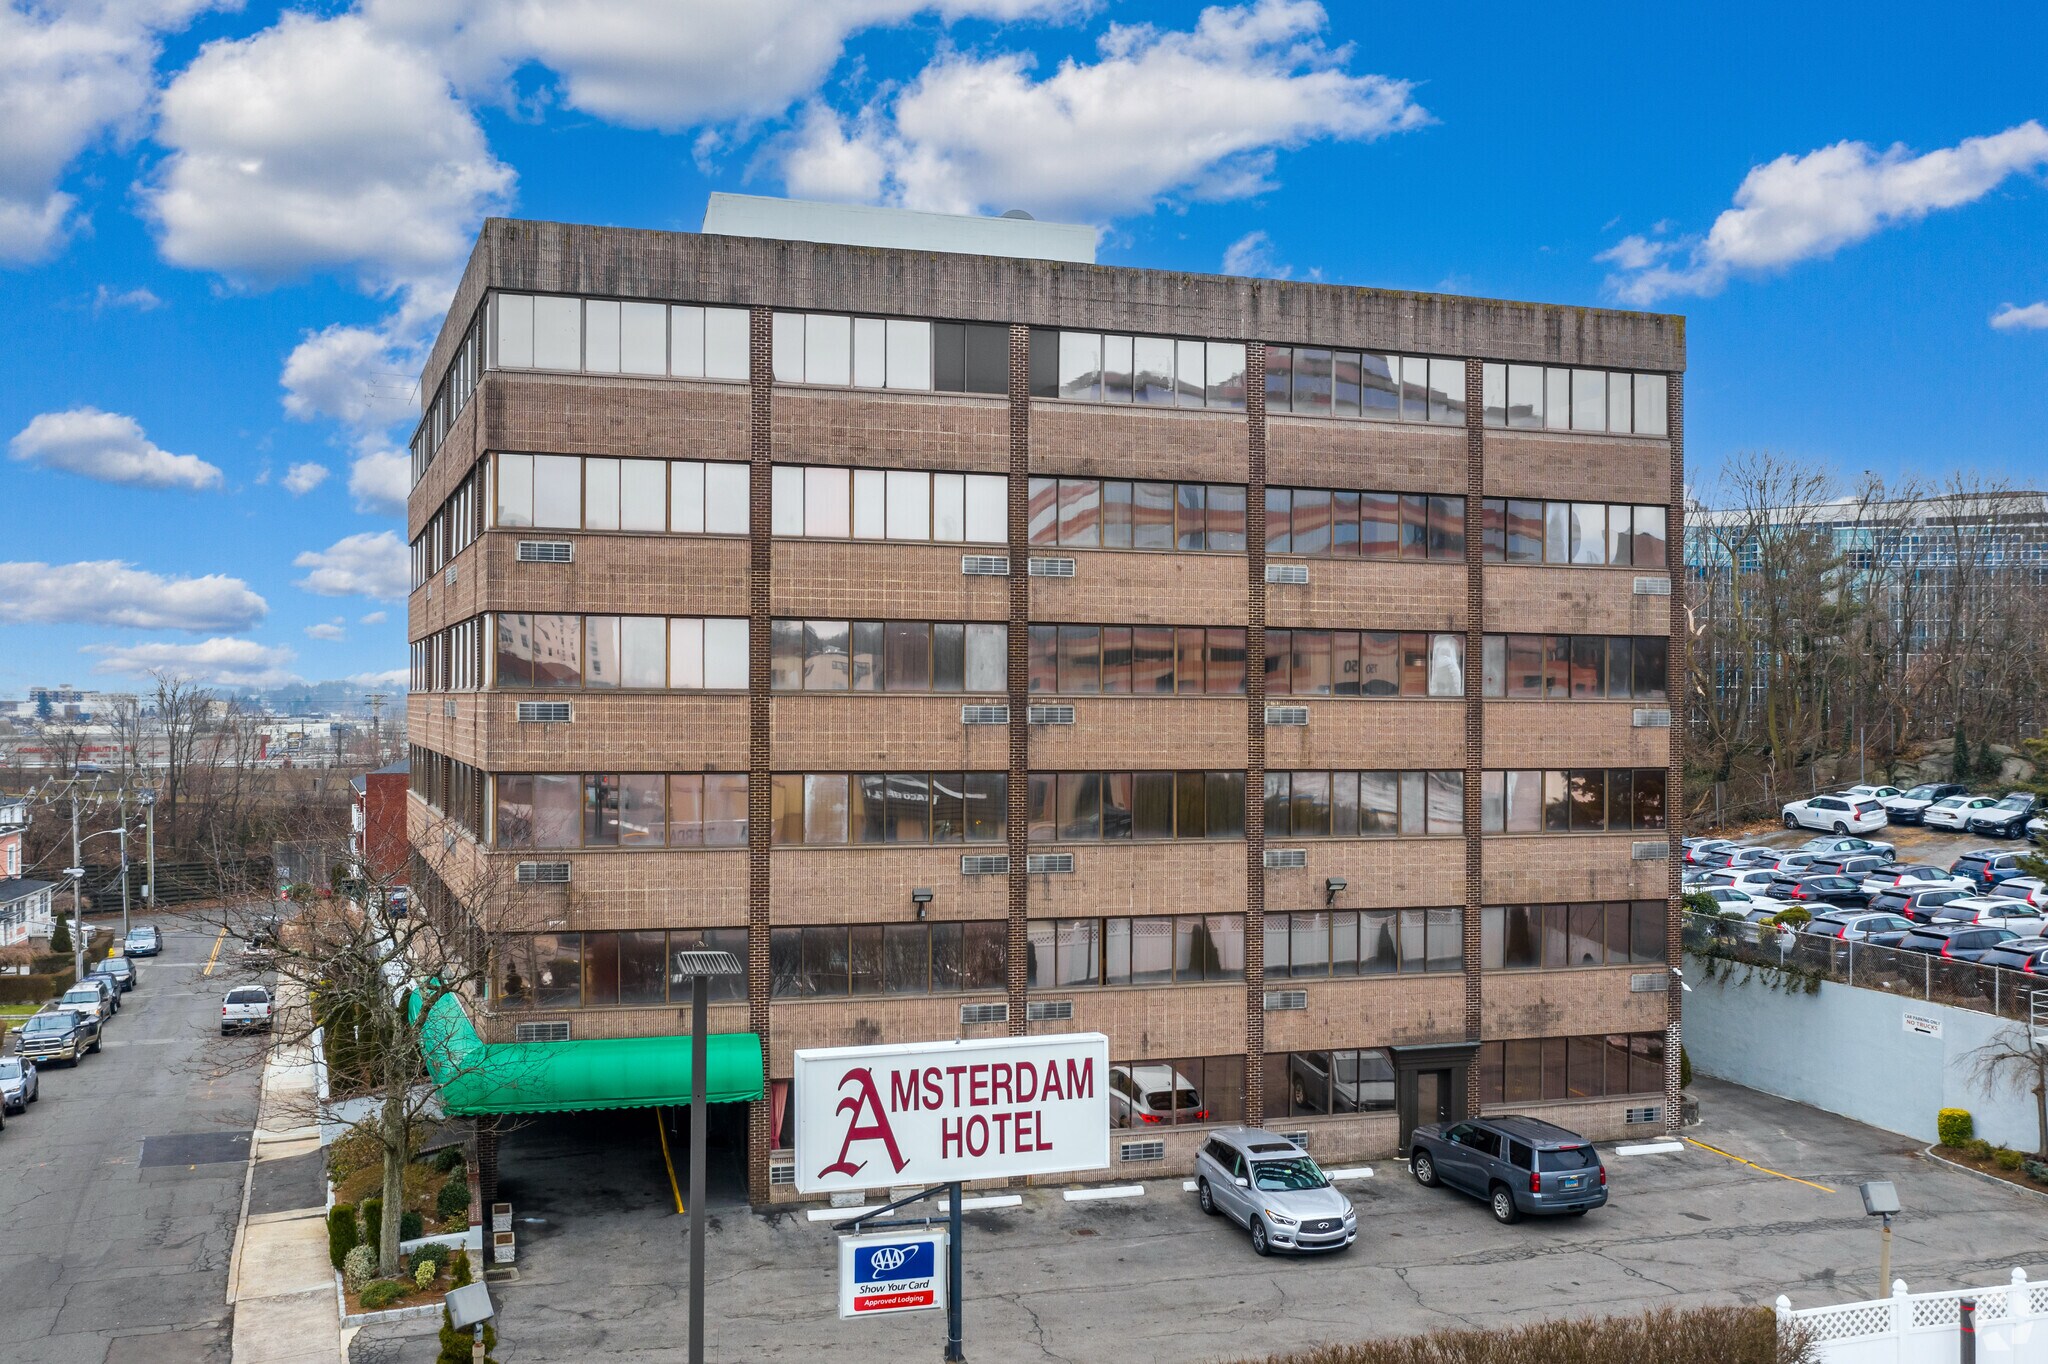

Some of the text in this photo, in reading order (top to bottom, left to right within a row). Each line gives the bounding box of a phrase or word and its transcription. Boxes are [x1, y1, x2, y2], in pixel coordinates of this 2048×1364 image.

[1917, 1022, 1937, 1030] TRUCKS
[817, 1057, 1094, 1180] AMSTERDAM
[941, 1110, 1053, 1159] HOTEL
[874, 1248, 902, 1270] AAA
[859, 1279, 930, 1294] Show Your Card
[864, 1295, 924, 1307] Approved Lodging
